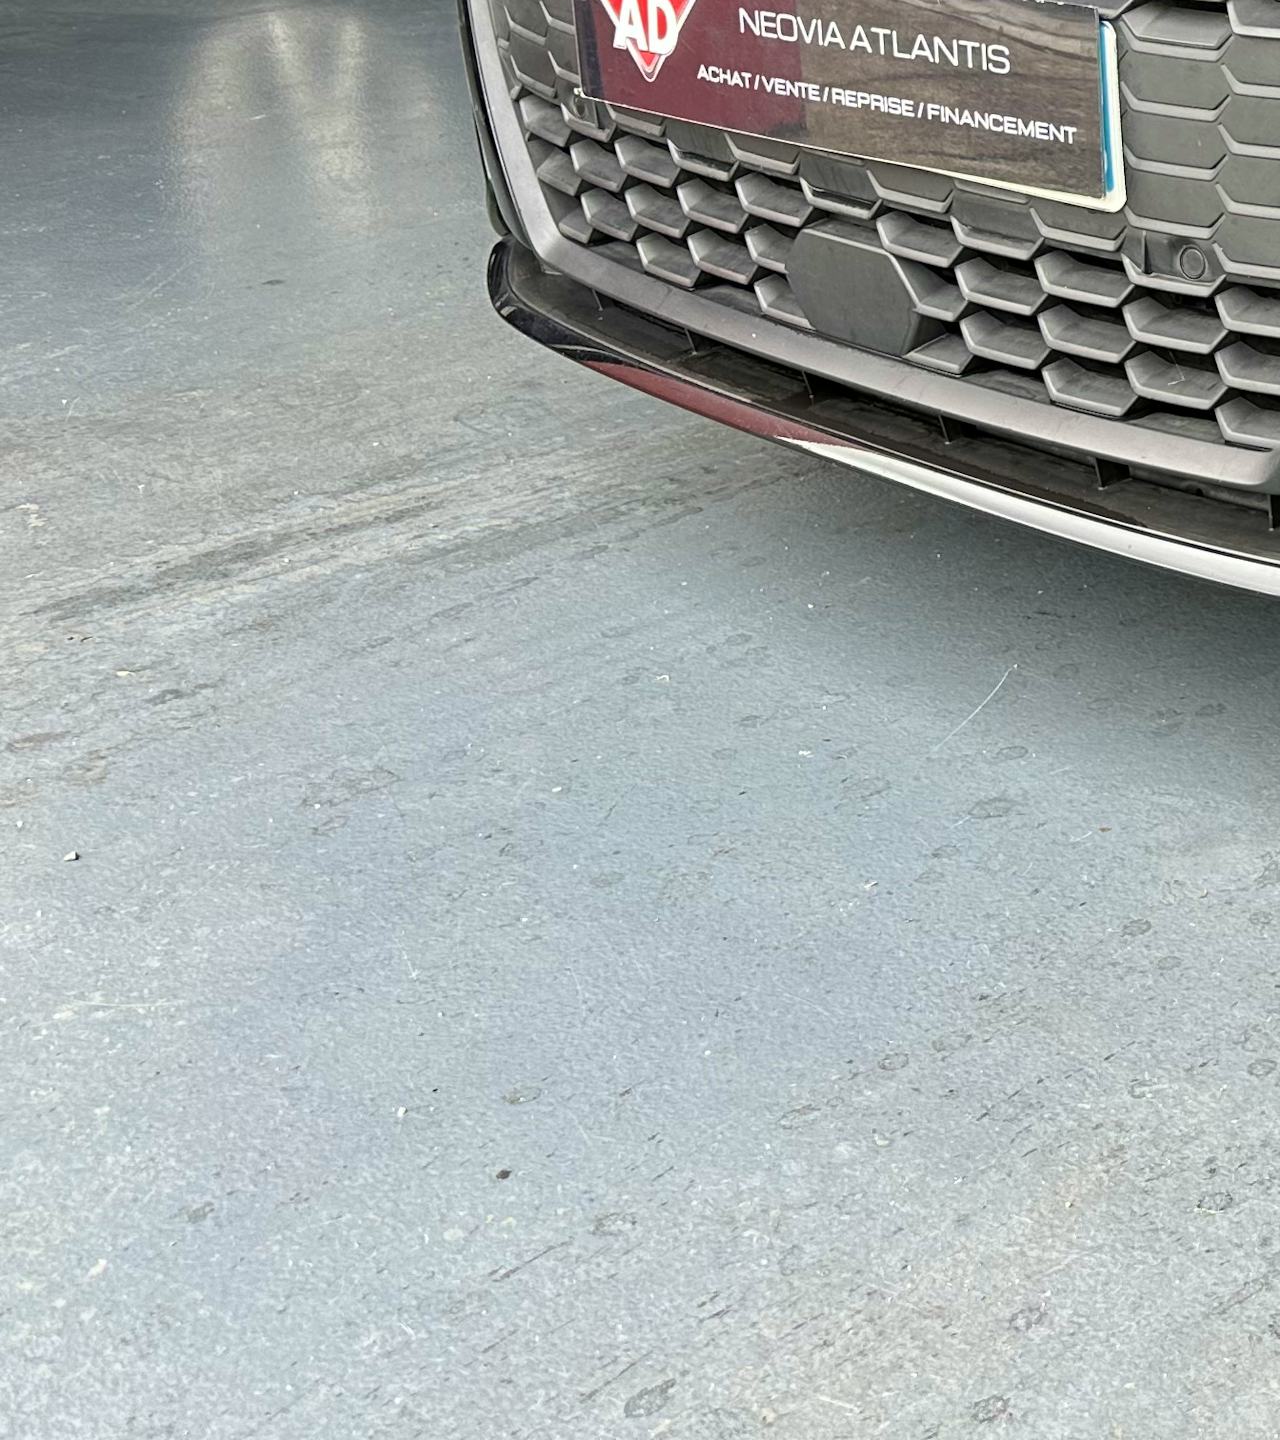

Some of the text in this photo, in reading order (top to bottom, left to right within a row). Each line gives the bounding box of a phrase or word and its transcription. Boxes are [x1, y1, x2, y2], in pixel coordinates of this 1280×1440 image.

[739, 7, 1011, 74] NEOVIA ATLANTIS
[697, 64, 752, 89] ACHAT
[762, 76, 820, 102] VENTE
[832, 88, 916, 118] REPRISE
[927, 103, 1077, 145] FINANCEMENT
